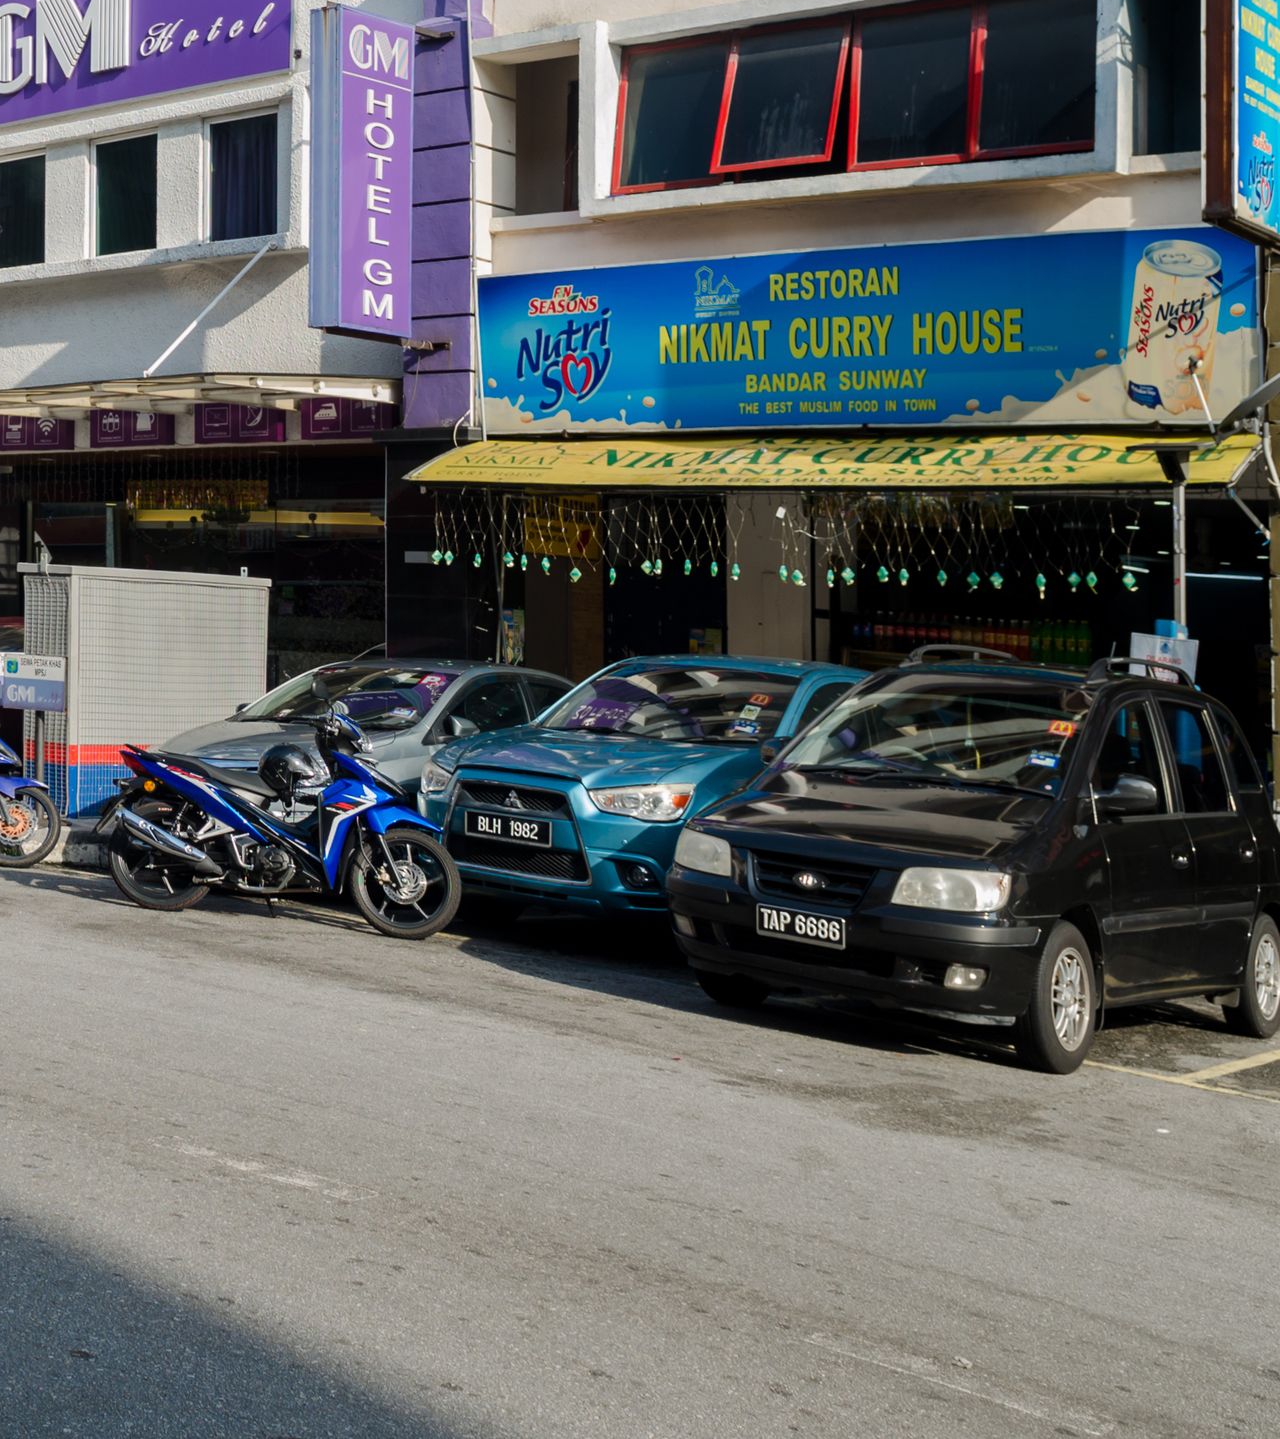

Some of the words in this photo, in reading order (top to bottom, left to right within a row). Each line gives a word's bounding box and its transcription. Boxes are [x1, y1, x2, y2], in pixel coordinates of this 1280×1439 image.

[140, 1, 276, 58] Hotel
[349, 24, 409, 81] GM
[363, 88, 395, 247] HOTEL
[362, 258, 394, 320] GM
[769, 266, 900, 302] RESTORAN
[528, 295, 598, 316] SEASONS
[695, 294, 740, 306] NIKMAT
[1155, 292, 1208, 322] Nutri
[1135, 284, 1155, 358] SEASONS
[516, 308, 612, 381] Nutri
[659, 320, 772, 365] NIKMAT
[789, 314, 894, 360] CURRY
[912, 308, 1025, 356] HOUSE
[745, 371, 826, 393] BANDAR
[839, 368, 928, 391] SUNWAY
[739, 403, 760, 415] THE
[765, 402, 793, 414] BEST
[799, 401, 842, 413] MUSLIM
[848, 400, 879, 413] FOOD
[885, 400, 898, 412] IN
[904, 399, 937, 412] TOWN
[589, 447, 809, 468] NIKMAT
[812, 444, 1014, 466] CURRY
[1016, 444, 1233, 466] HOUE
[677, 466, 866, 476] BANDAR
[799, 476, 878, 484] MUSLIM
[7, 684, 35, 703] GM
[478, 816, 501, 835] BLH
[509, 820, 538, 840] 1982
[760, 907, 791, 932] TAP
[794, 914, 840, 941] 6686
